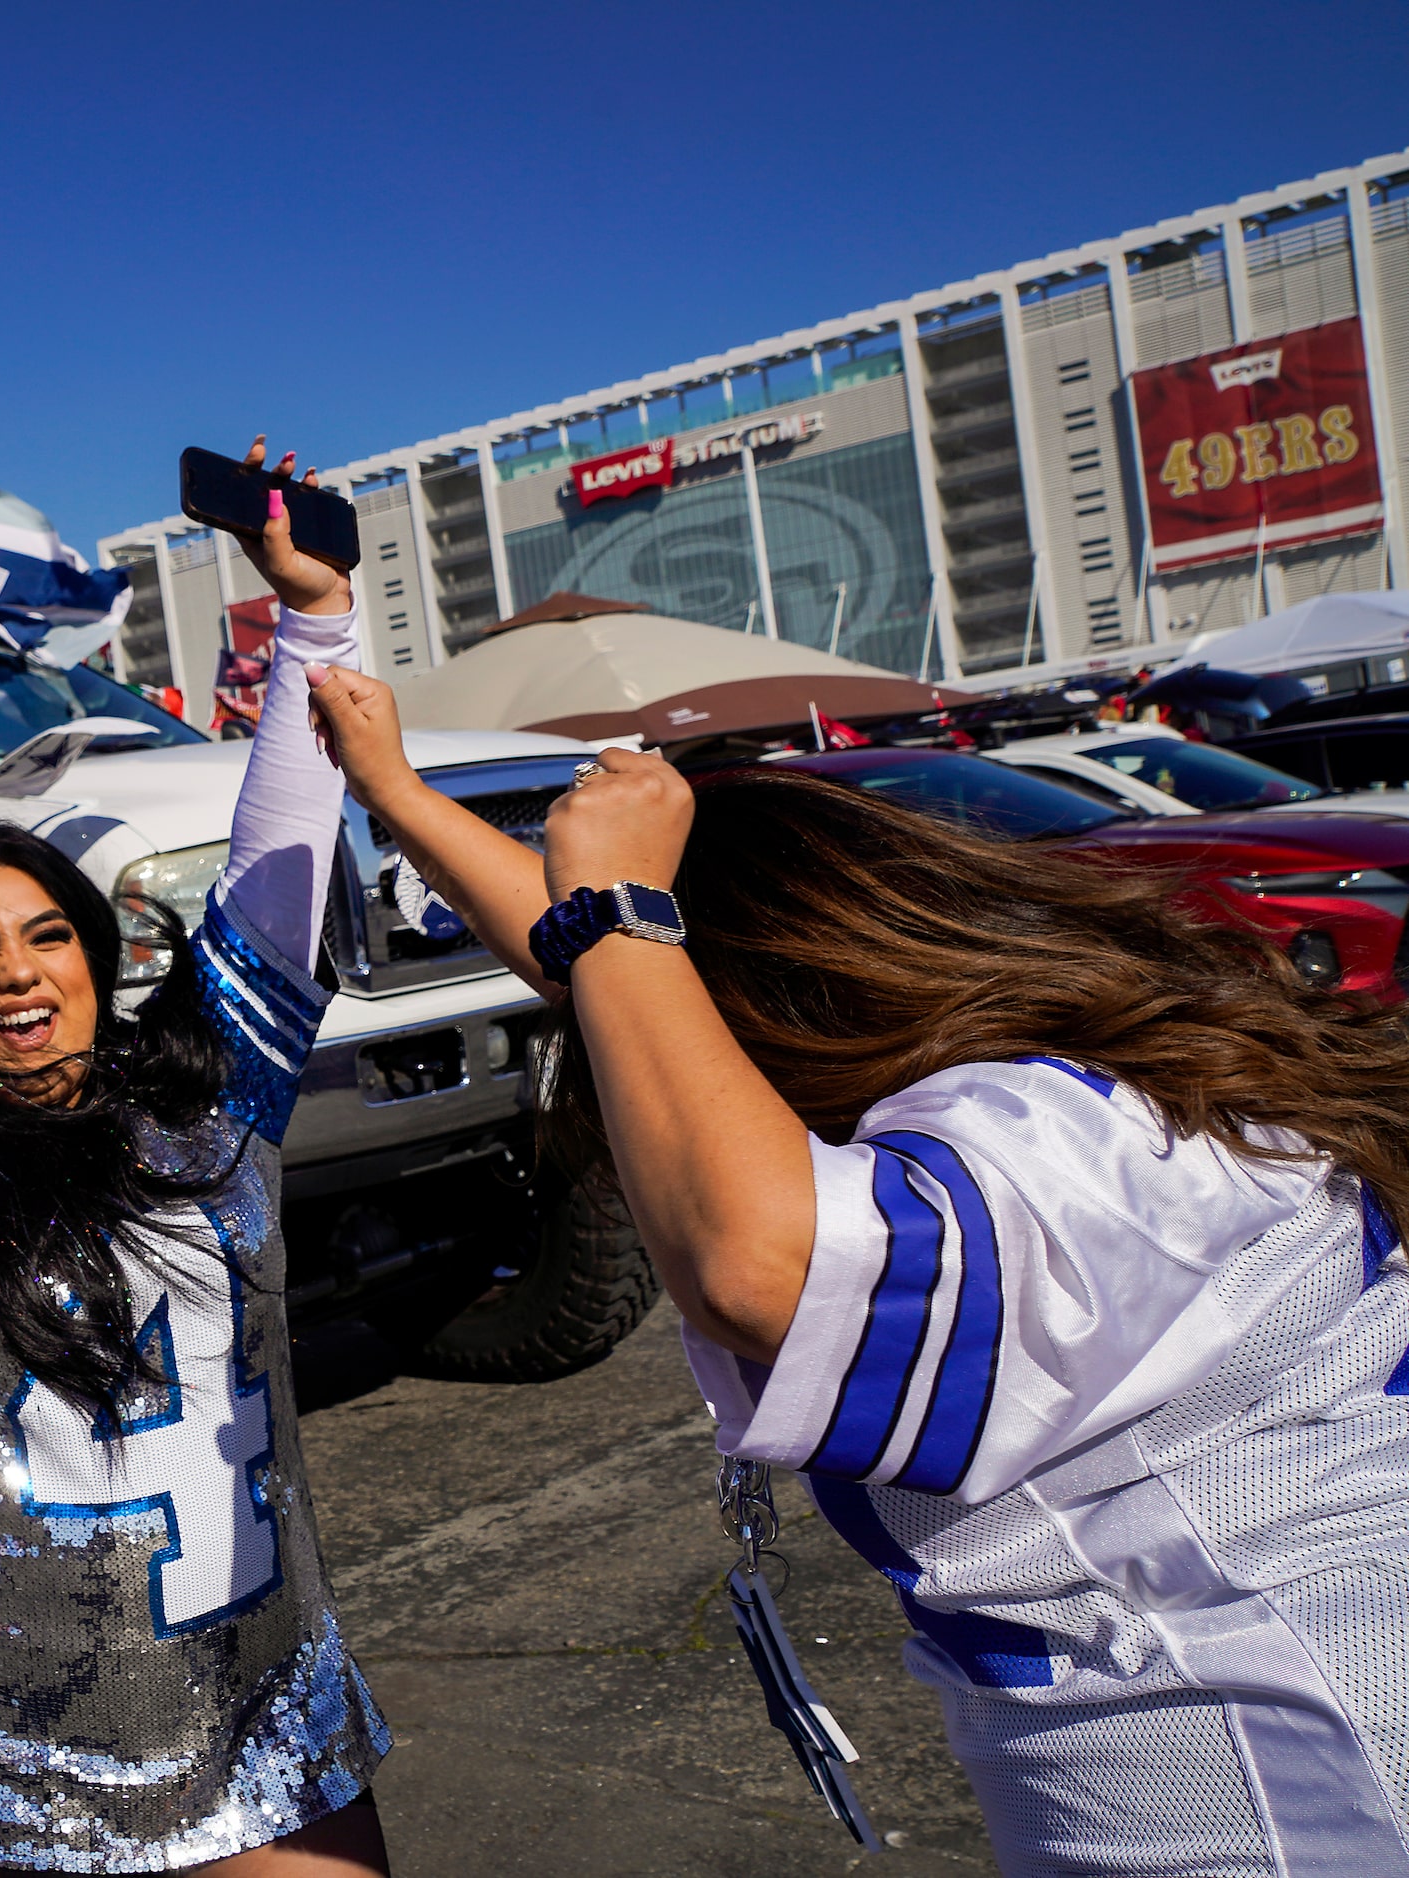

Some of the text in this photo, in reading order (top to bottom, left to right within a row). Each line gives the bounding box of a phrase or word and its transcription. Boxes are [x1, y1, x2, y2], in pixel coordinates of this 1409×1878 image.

[674, 412, 809, 468] STADIUM
[1159, 404, 1360, 499] 49ERS
[4, 1200, 283, 1641] 4
